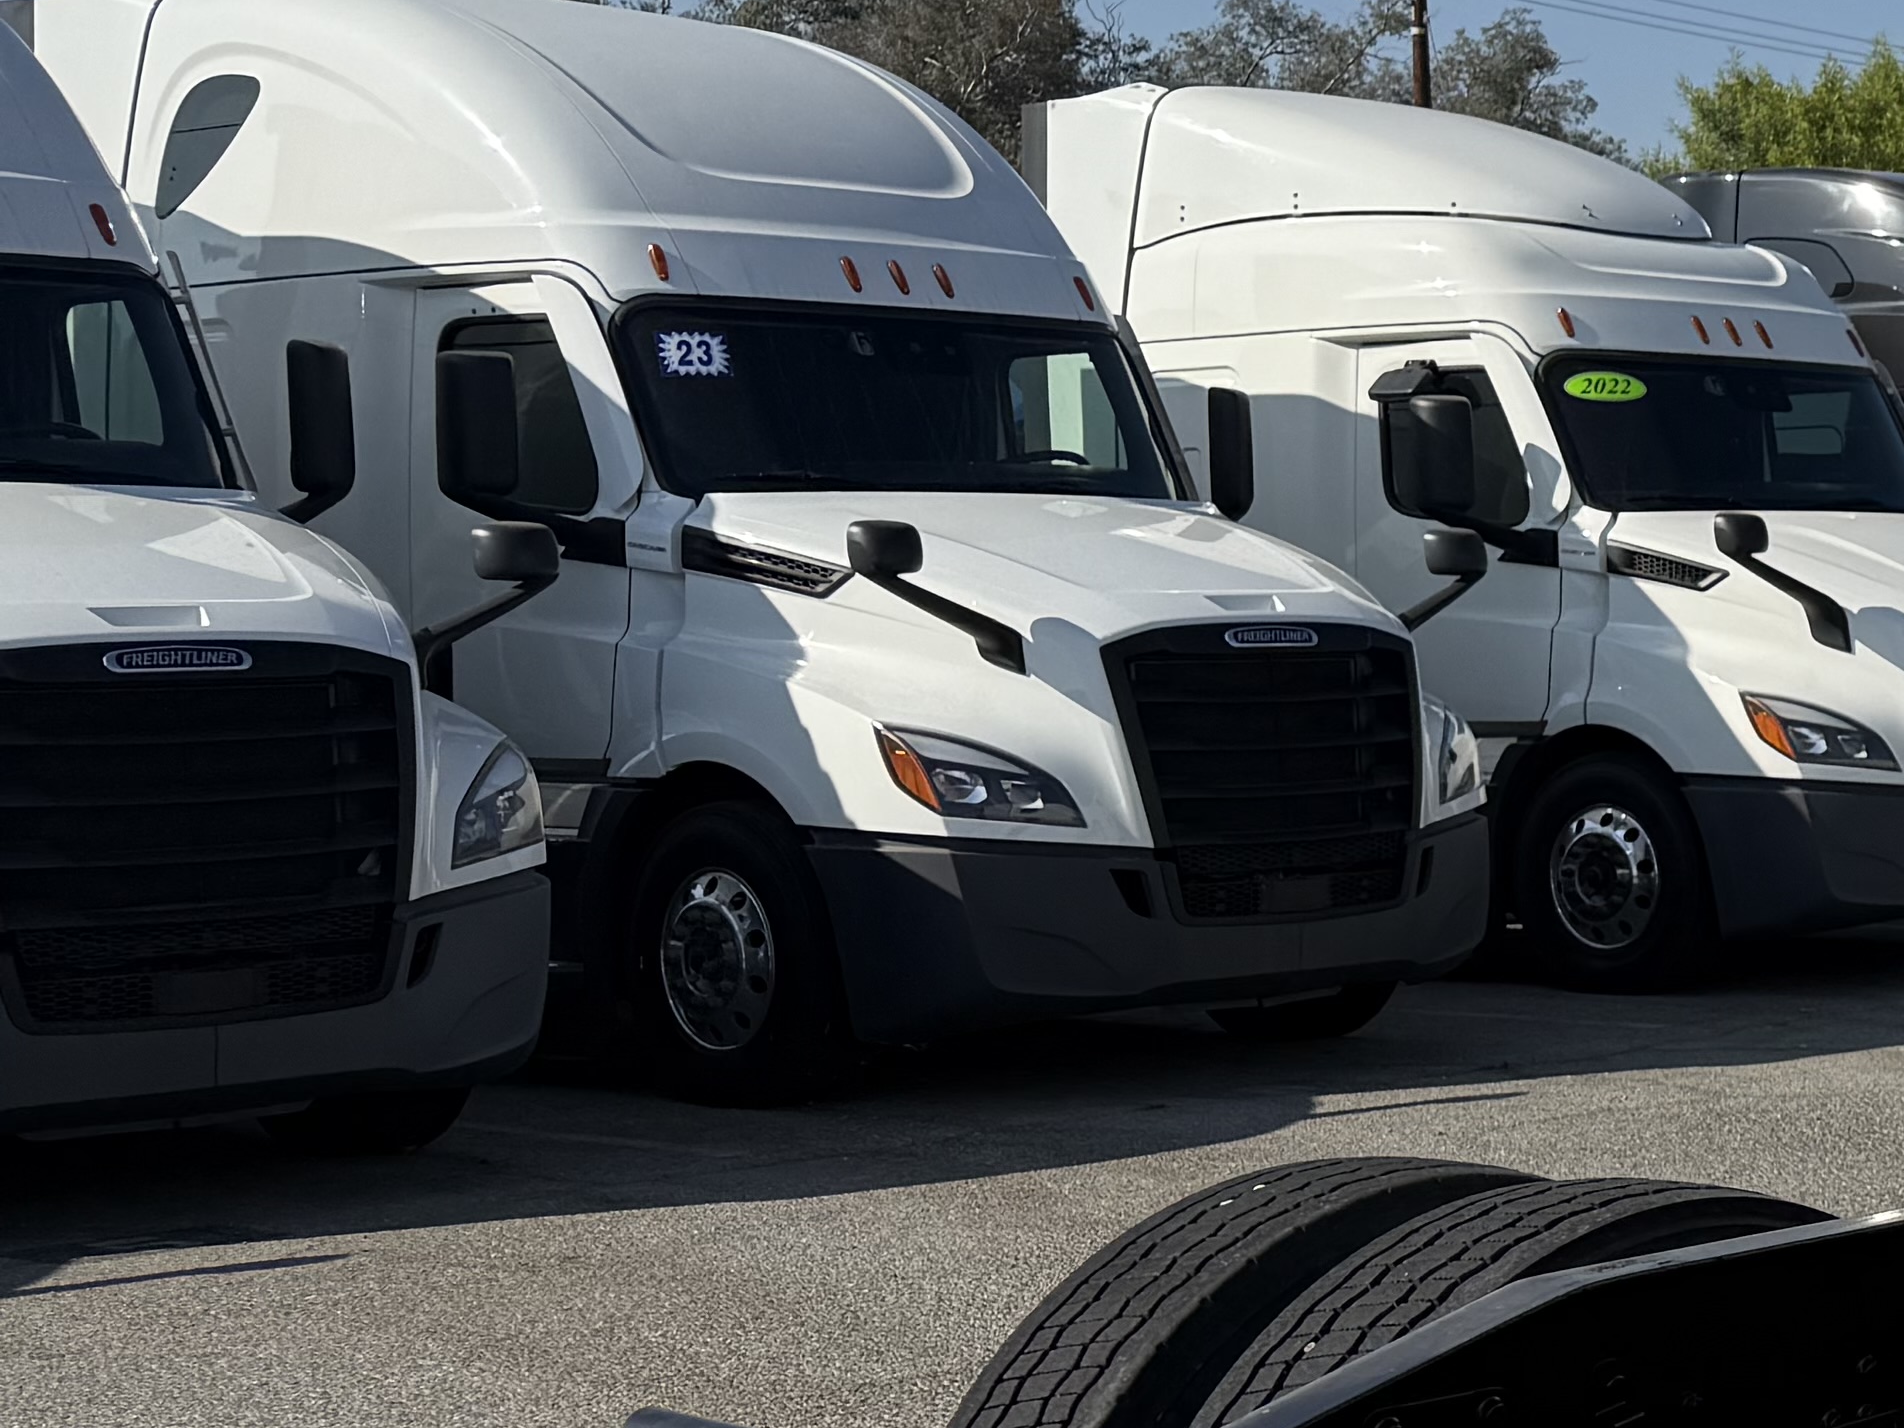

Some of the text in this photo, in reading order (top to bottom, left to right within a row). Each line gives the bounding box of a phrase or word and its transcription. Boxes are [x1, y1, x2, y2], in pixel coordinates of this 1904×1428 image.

[676, 339, 713, 367] 23
[1580, 377, 1632, 395] 2022
[122, 650, 238, 667] FREIGHTLINER
